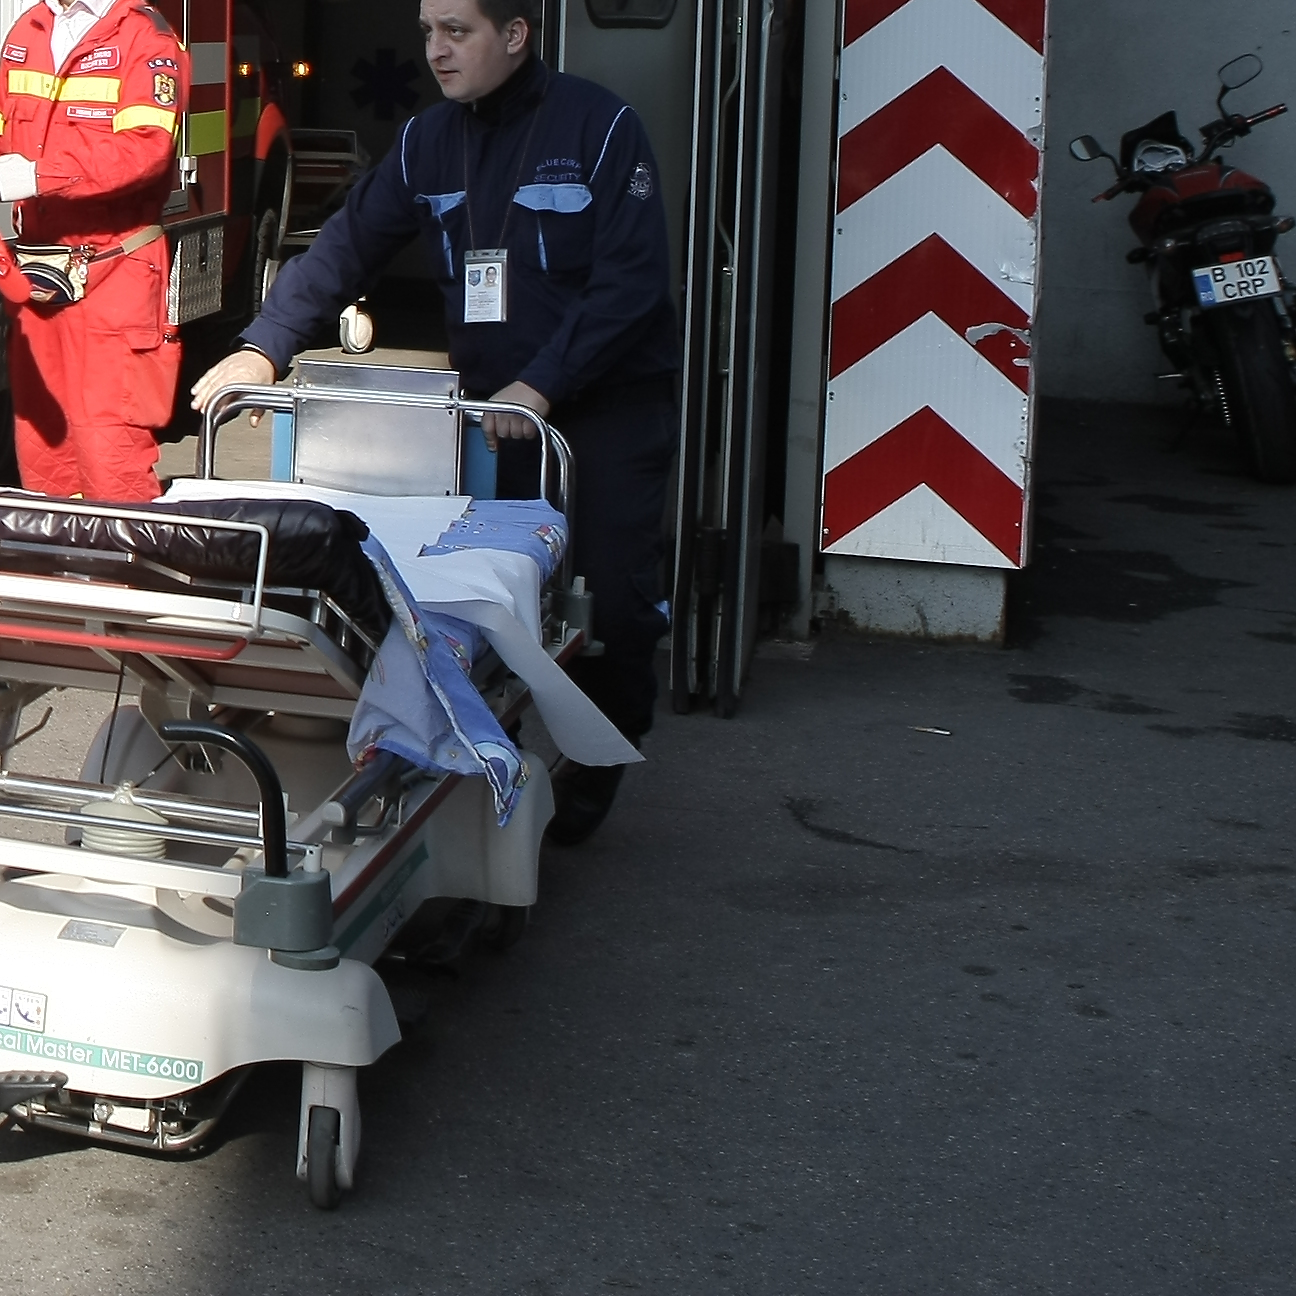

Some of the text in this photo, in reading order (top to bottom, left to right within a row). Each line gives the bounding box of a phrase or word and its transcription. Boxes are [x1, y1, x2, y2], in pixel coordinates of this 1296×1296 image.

[1212, 260, 1269, 282] B 102
[1223, 278, 1265, 298] CRP
[26, 1033, 92, 1063] Master
[101, 1048, 199, 1081] MET-6600
